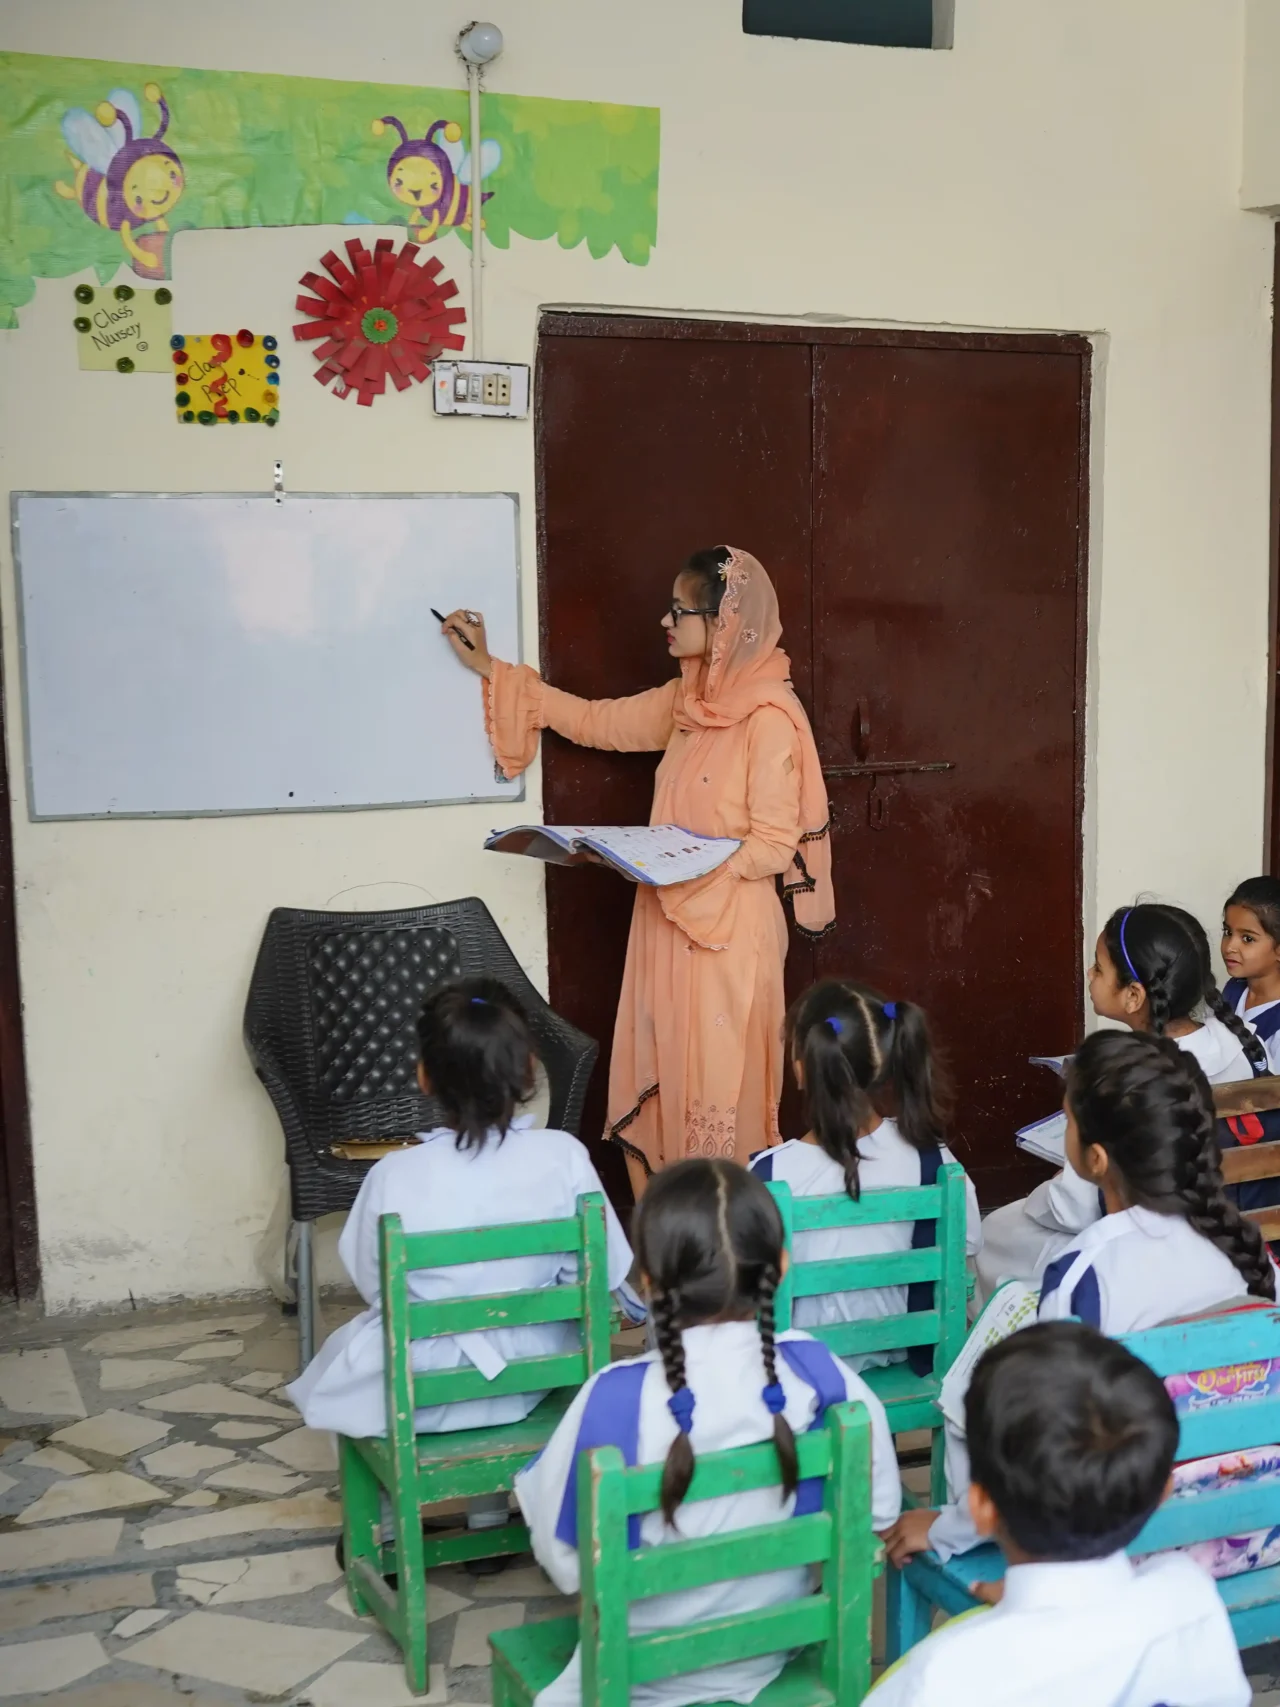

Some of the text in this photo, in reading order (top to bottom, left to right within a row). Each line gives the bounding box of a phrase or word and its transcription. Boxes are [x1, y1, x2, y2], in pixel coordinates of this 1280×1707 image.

[93, 305, 134, 329] Class
[91, 322, 141, 352] Nursery
[187, 360, 217, 382] Cla
